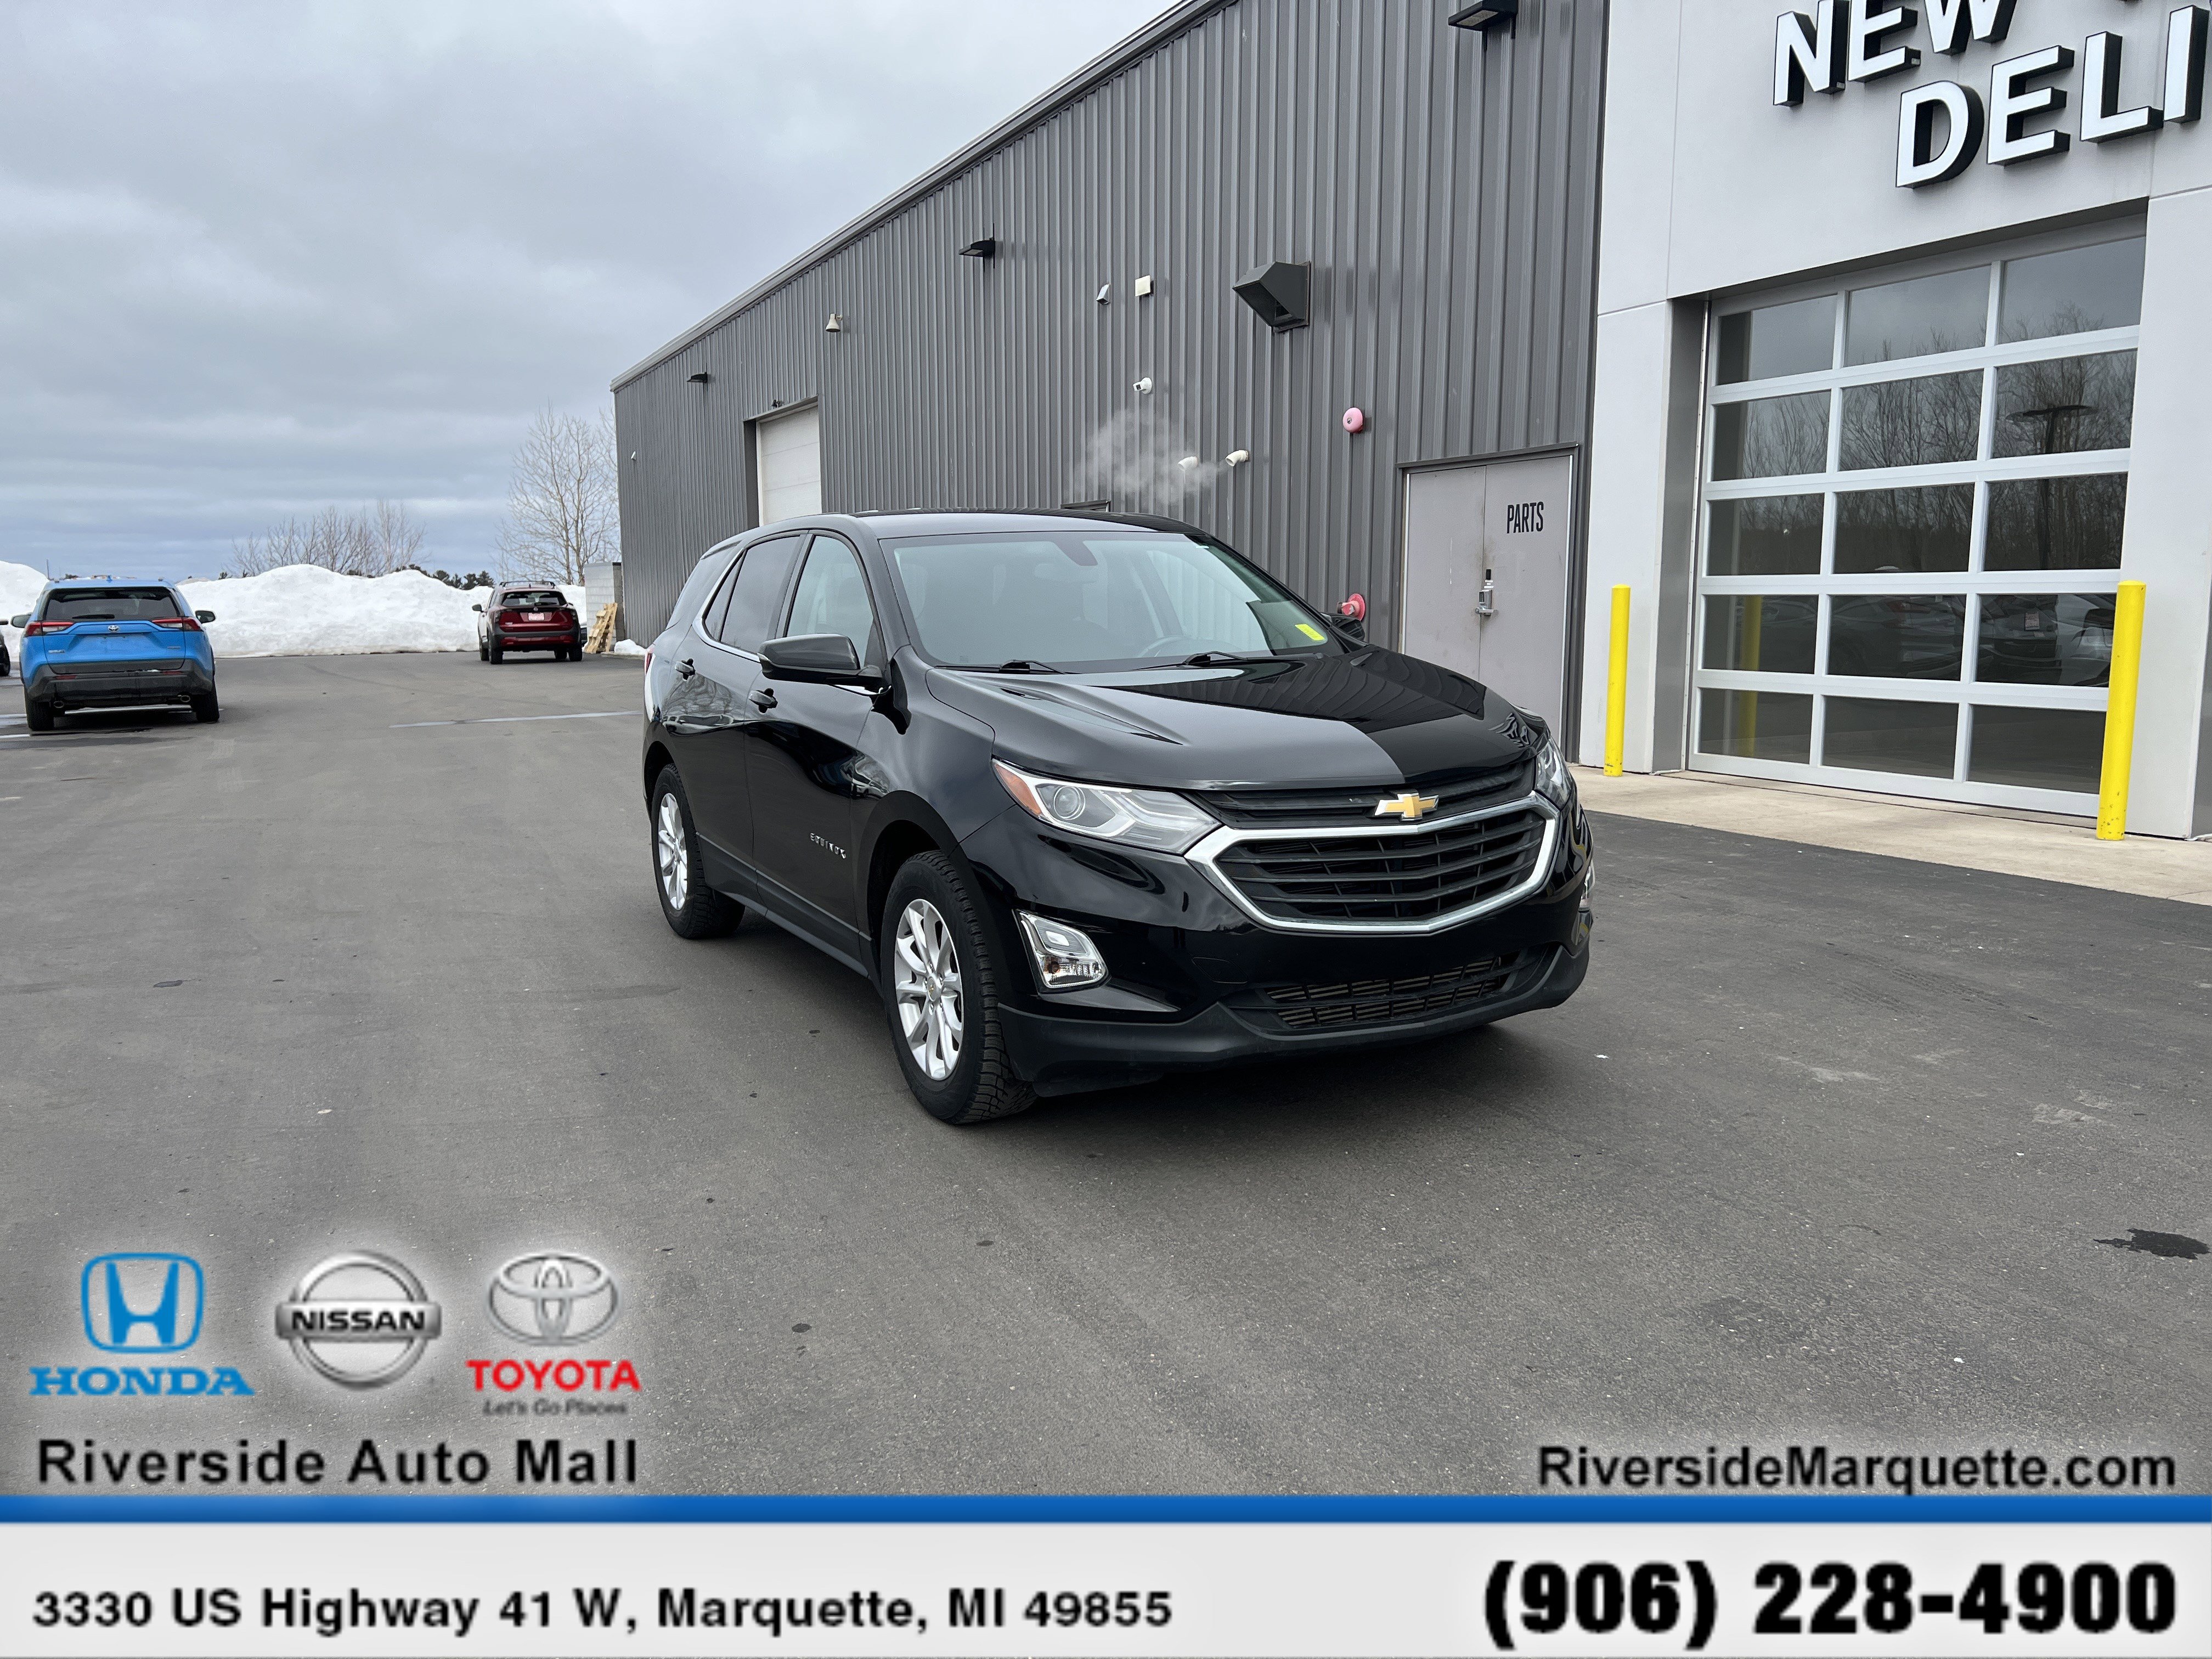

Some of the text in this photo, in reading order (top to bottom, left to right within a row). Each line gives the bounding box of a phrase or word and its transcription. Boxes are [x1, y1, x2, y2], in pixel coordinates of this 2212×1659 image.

[1773, 0, 2016, 105] NEW
[1895, 4, 2212, 188] DELI
[1506, 501, 1544, 534] PARTS
